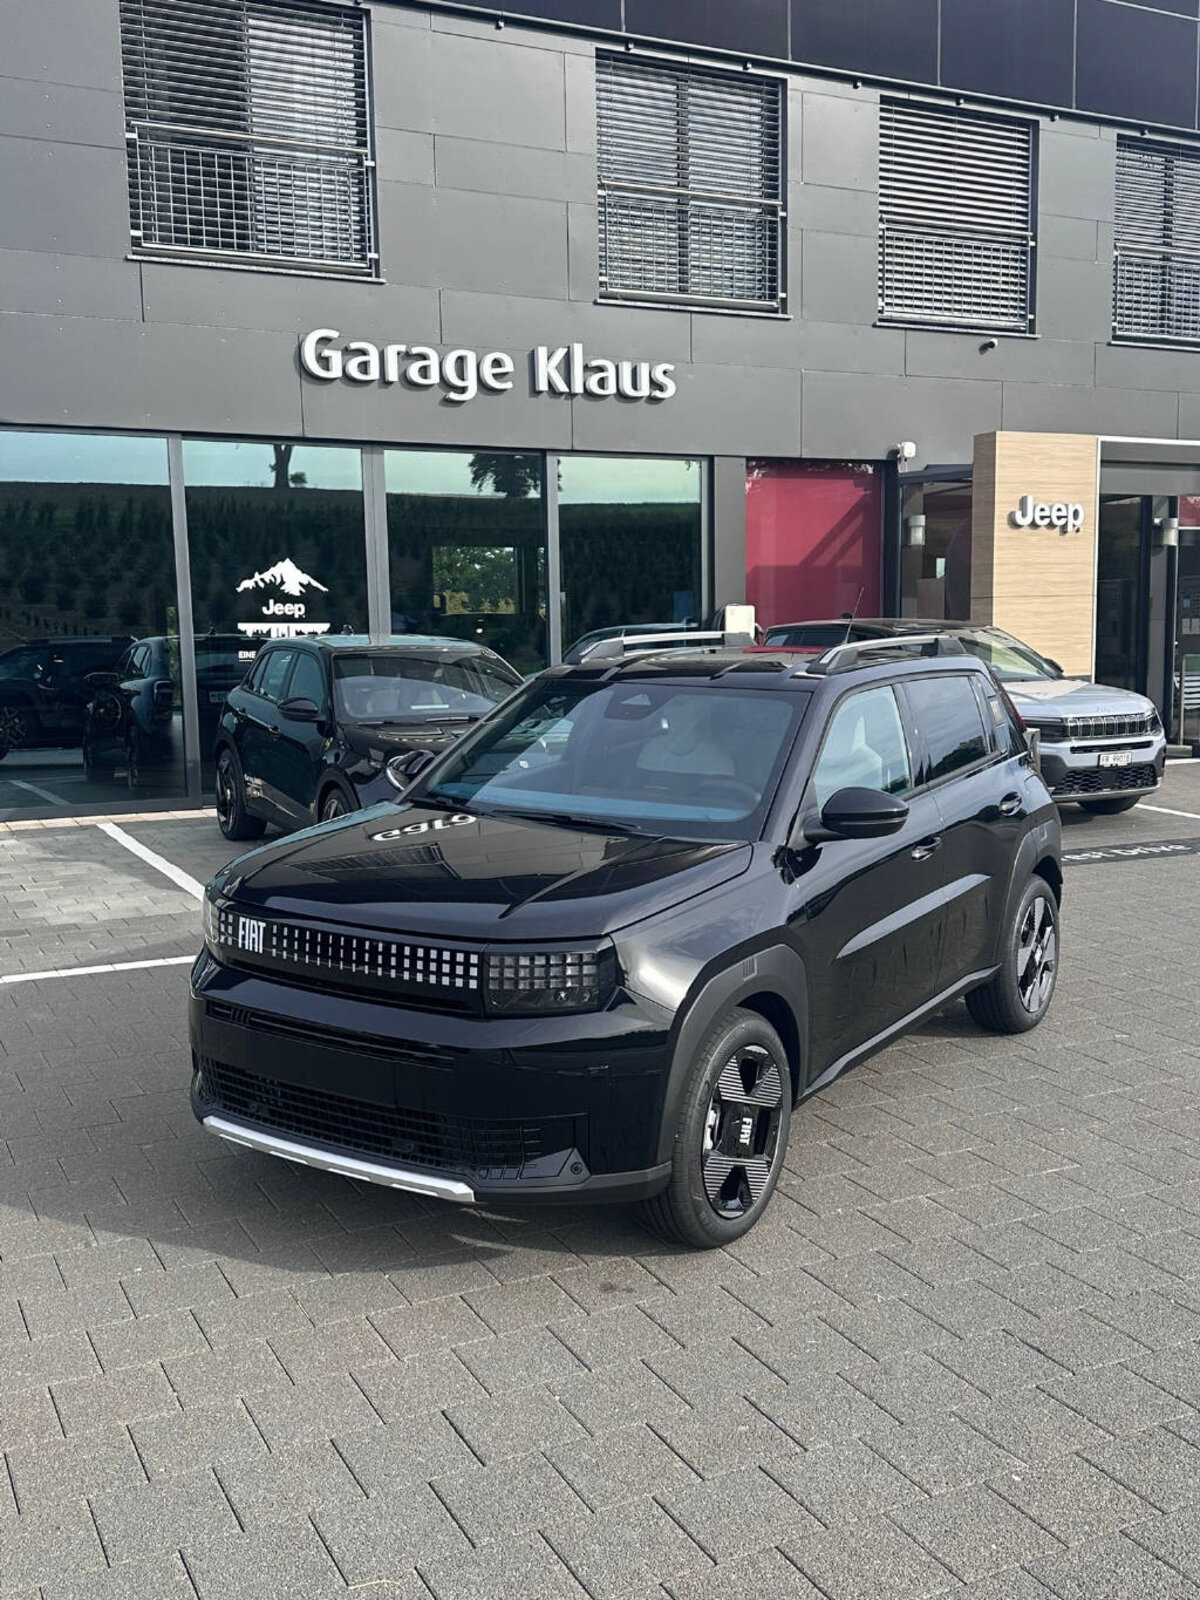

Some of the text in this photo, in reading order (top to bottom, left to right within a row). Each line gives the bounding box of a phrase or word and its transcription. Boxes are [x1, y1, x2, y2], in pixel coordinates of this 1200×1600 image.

[300, 328, 677, 401] Garage Klaus
[1013, 493, 1084, 533] Jeep
[262, 599, 305, 618] Jeep
[1061, 844, 1192, 861] est Drive
[238, 916, 266, 954] FIAT
[739, 1117, 753, 1146] FIAT
